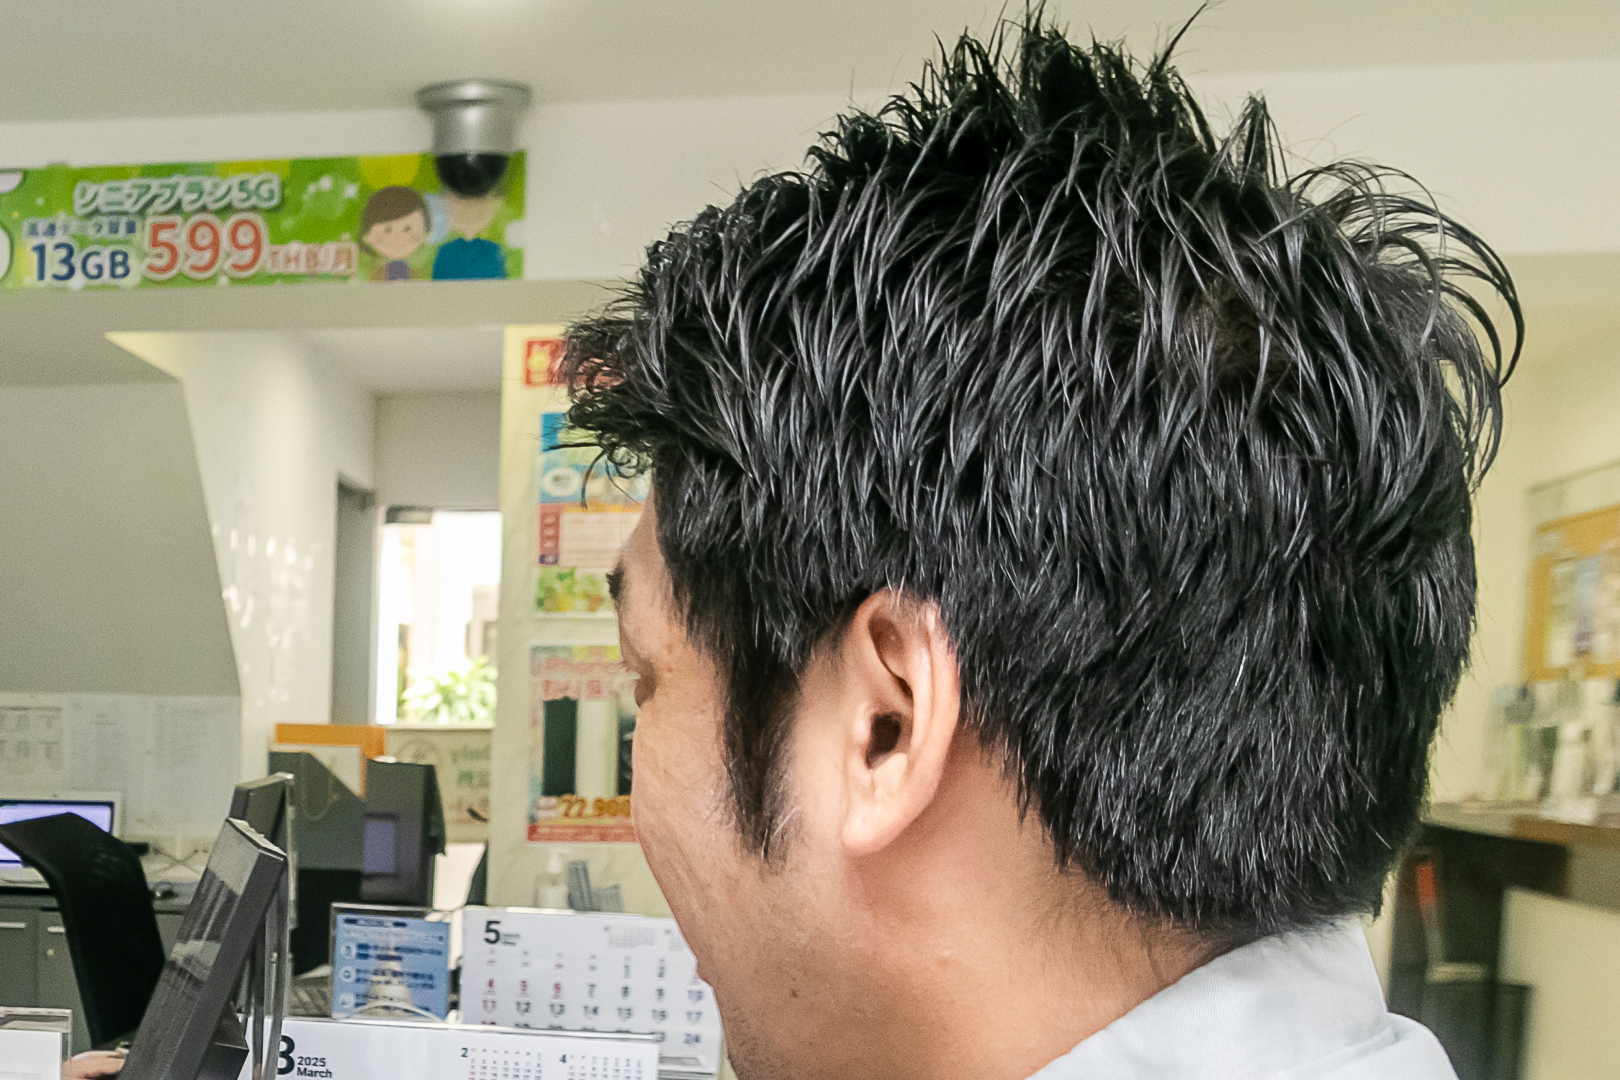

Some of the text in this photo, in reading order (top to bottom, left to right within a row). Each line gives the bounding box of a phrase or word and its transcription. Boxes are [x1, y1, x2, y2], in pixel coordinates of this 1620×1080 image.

[32, 241, 130, 281] 13GB
[147, 219, 262, 273] 599
[484, 920, 501, 945] 5
[277, 1034, 296, 1075] 3
[460, 1047, 468, 1058] 2
[297, 1056, 326, 1067] 2025
[559, 1054, 567, 1064] 4
[297, 1067, 333, 1079] March
